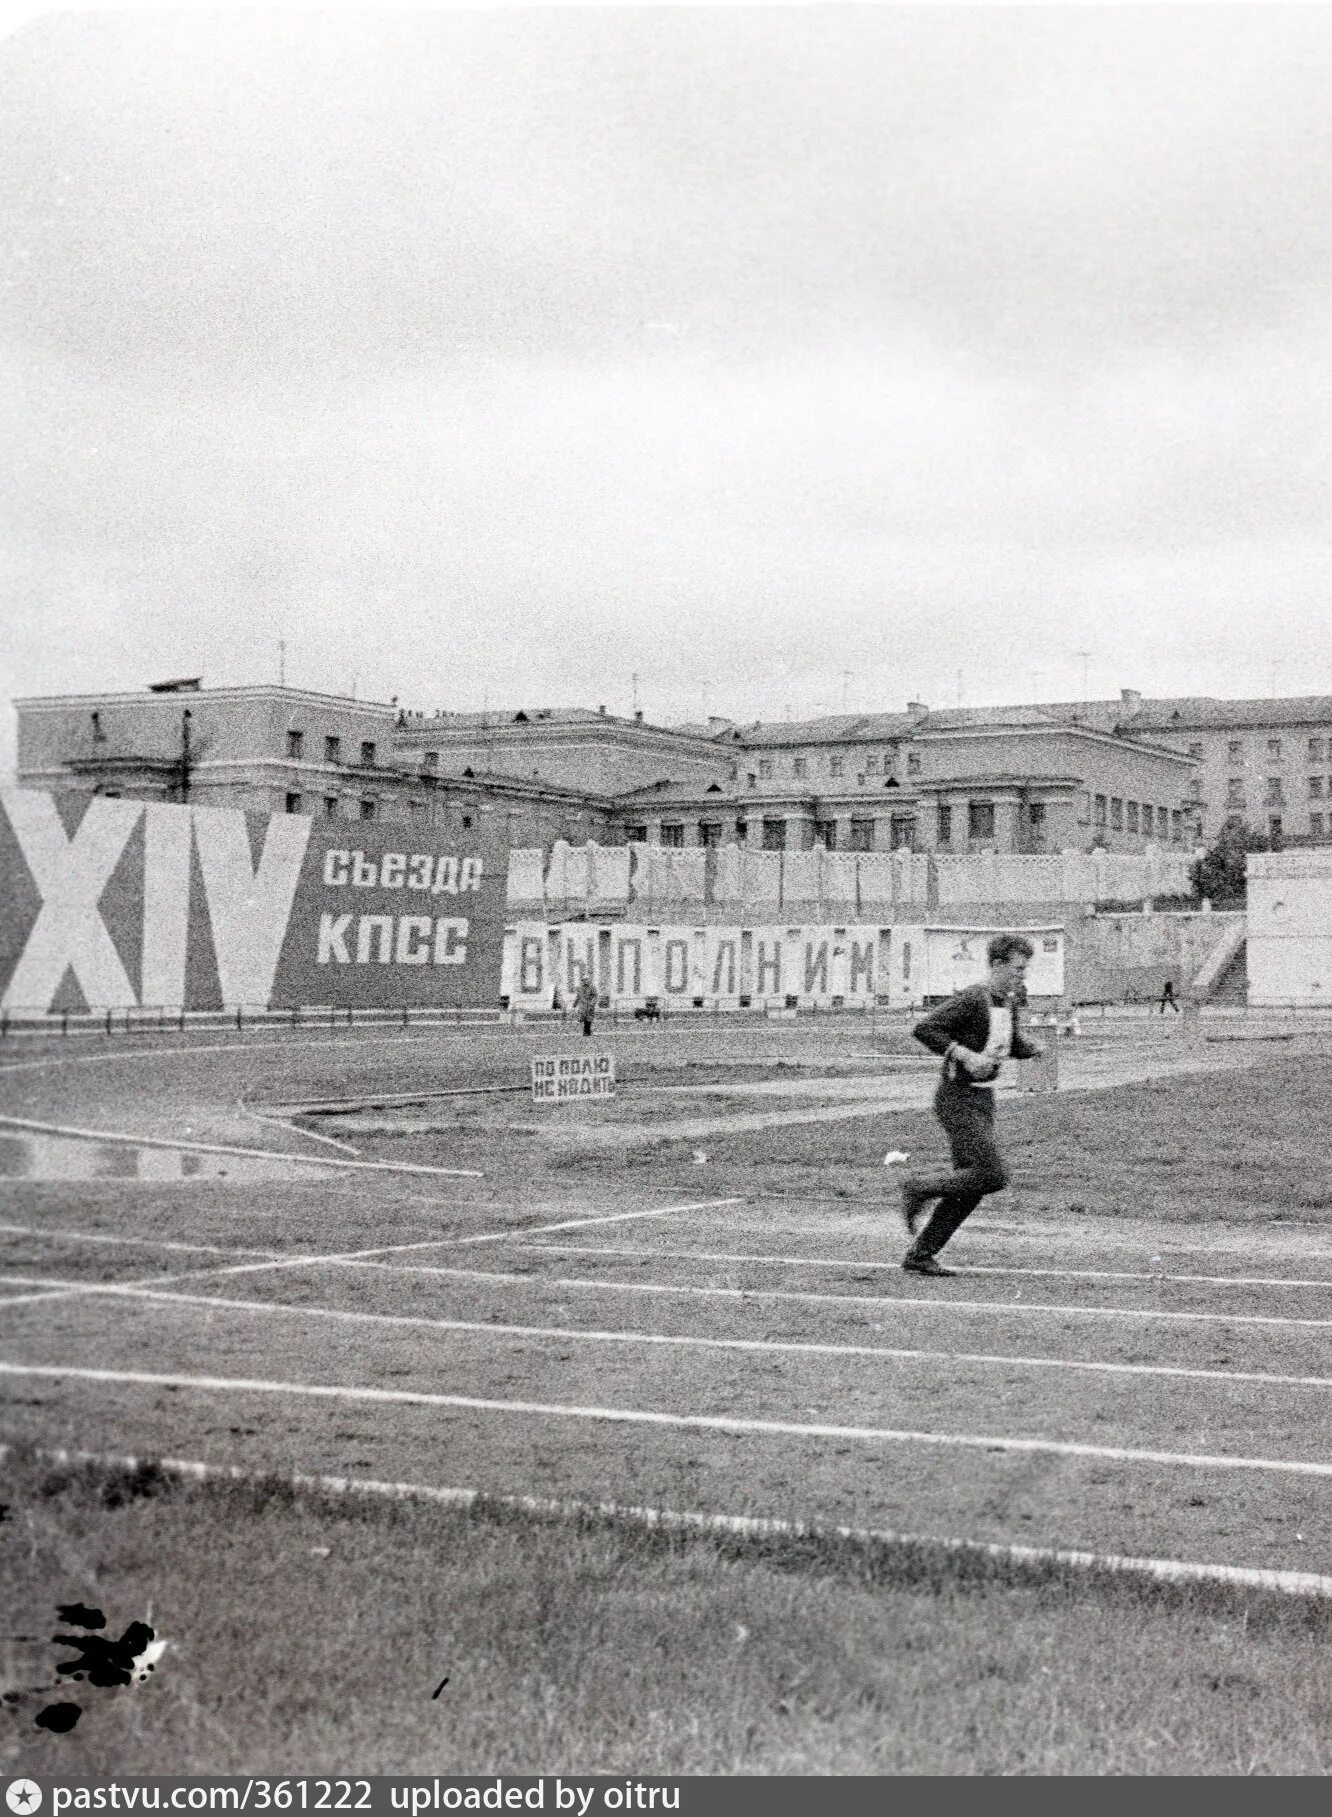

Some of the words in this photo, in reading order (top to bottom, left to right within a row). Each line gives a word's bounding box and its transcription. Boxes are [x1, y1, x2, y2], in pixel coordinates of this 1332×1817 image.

[0, 786, 313, 1014] XIV
[317, 913, 469, 964] КПСС
[520, 936, 911, 994] ВЫПОЛНИМ!
[534, 1080, 555, 1097] НЕ
[535, 1060, 555, 1077] ПО
[560, 1057, 610, 1075] ПОЛЮ
